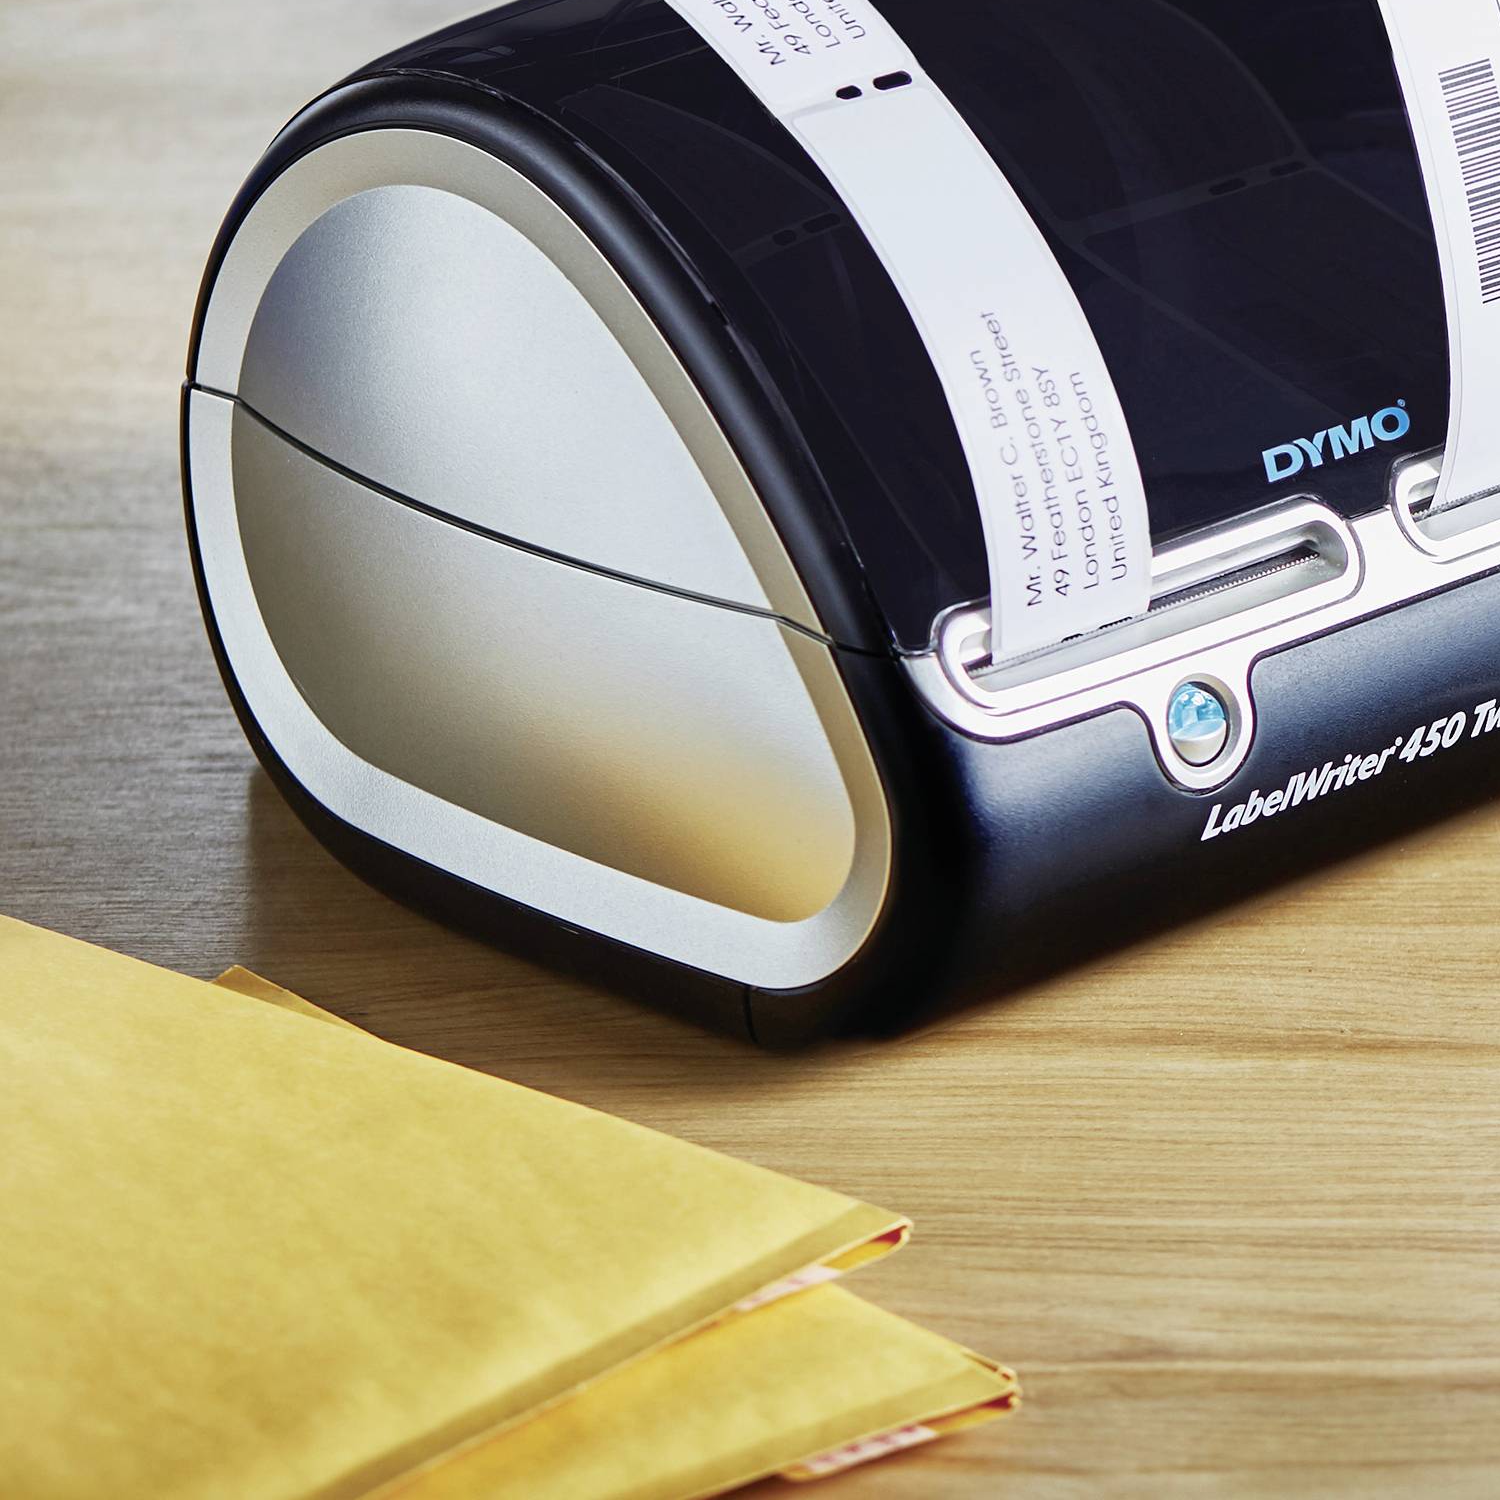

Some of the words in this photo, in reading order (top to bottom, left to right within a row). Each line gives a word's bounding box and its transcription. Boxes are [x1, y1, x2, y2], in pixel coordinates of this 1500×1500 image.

[755, 34, 787, 66] Mr.
[783, 34, 811, 56] 49
[980, 312, 1021, 382] Street
[970, 349, 1008, 428] Brown
[1031, 366, 1060, 407] 8SY
[1000, 436, 1018, 466] C.
[1049, 418, 1083, 482] EC1Y
[1070, 371, 1114, 489] Kingdom
[1015, 388, 1068, 560] Featherstone
[1012, 474, 1038, 560] Walter
[1075, 489, 1100, 590] London
[1102, 495, 1128, 581] United
[1026, 565, 1043, 607] Mr.
[1053, 568, 1070, 596] 49
[1398, 711, 1466, 764] 450
